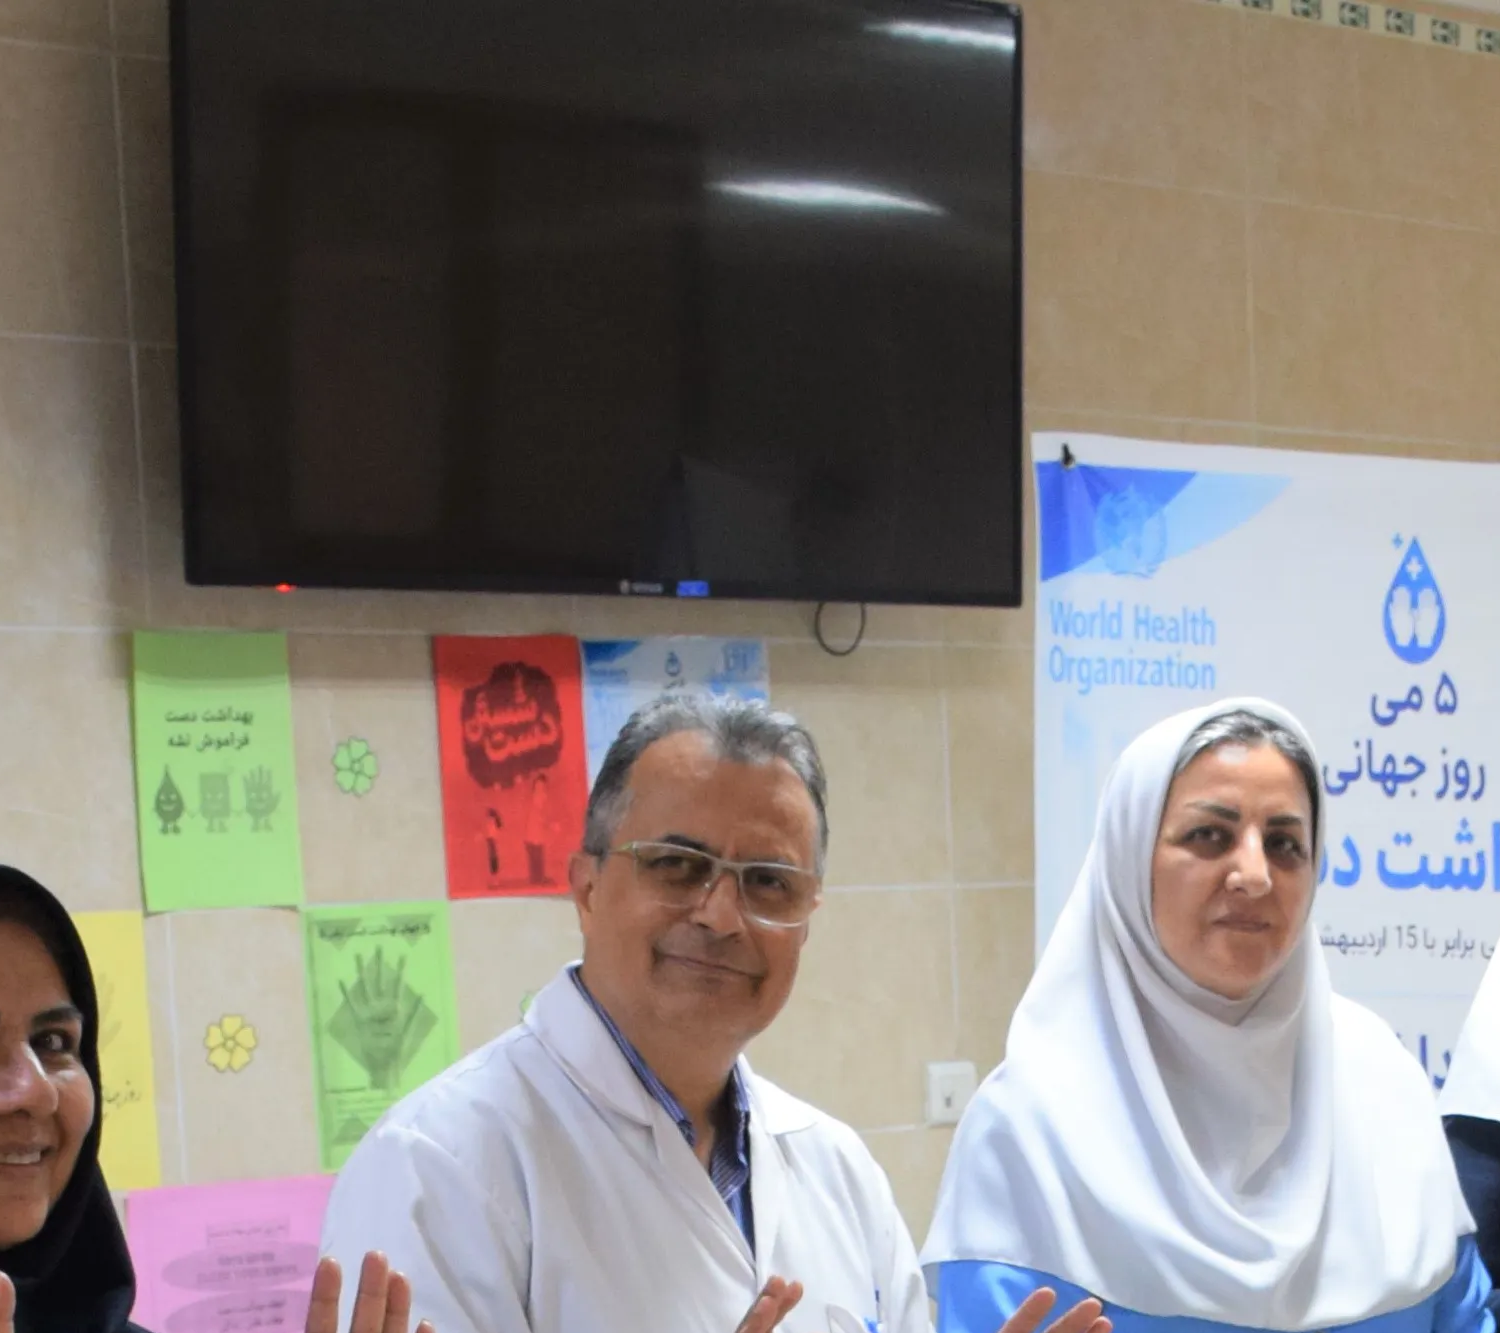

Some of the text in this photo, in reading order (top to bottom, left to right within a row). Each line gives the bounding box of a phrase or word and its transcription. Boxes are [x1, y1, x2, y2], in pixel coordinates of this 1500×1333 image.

[1050, 599, 1217, 647] World Health
[1049, 645, 1217, 695] Organization
[1371, 671, 1458, 726] ۵ می
[164, 706, 254, 725] بهداشت دست
[168, 732, 249, 752] فراموش نشه
[1323, 741, 1427, 799] جهانی
[1436, 750, 1487, 800] روز
[1320, 925, 1387, 956] اردیبهش
[1396, 925, 1418, 950] 15
[1423, 928, 1436, 957] با
[1441, 928, 1475, 959] برابر
